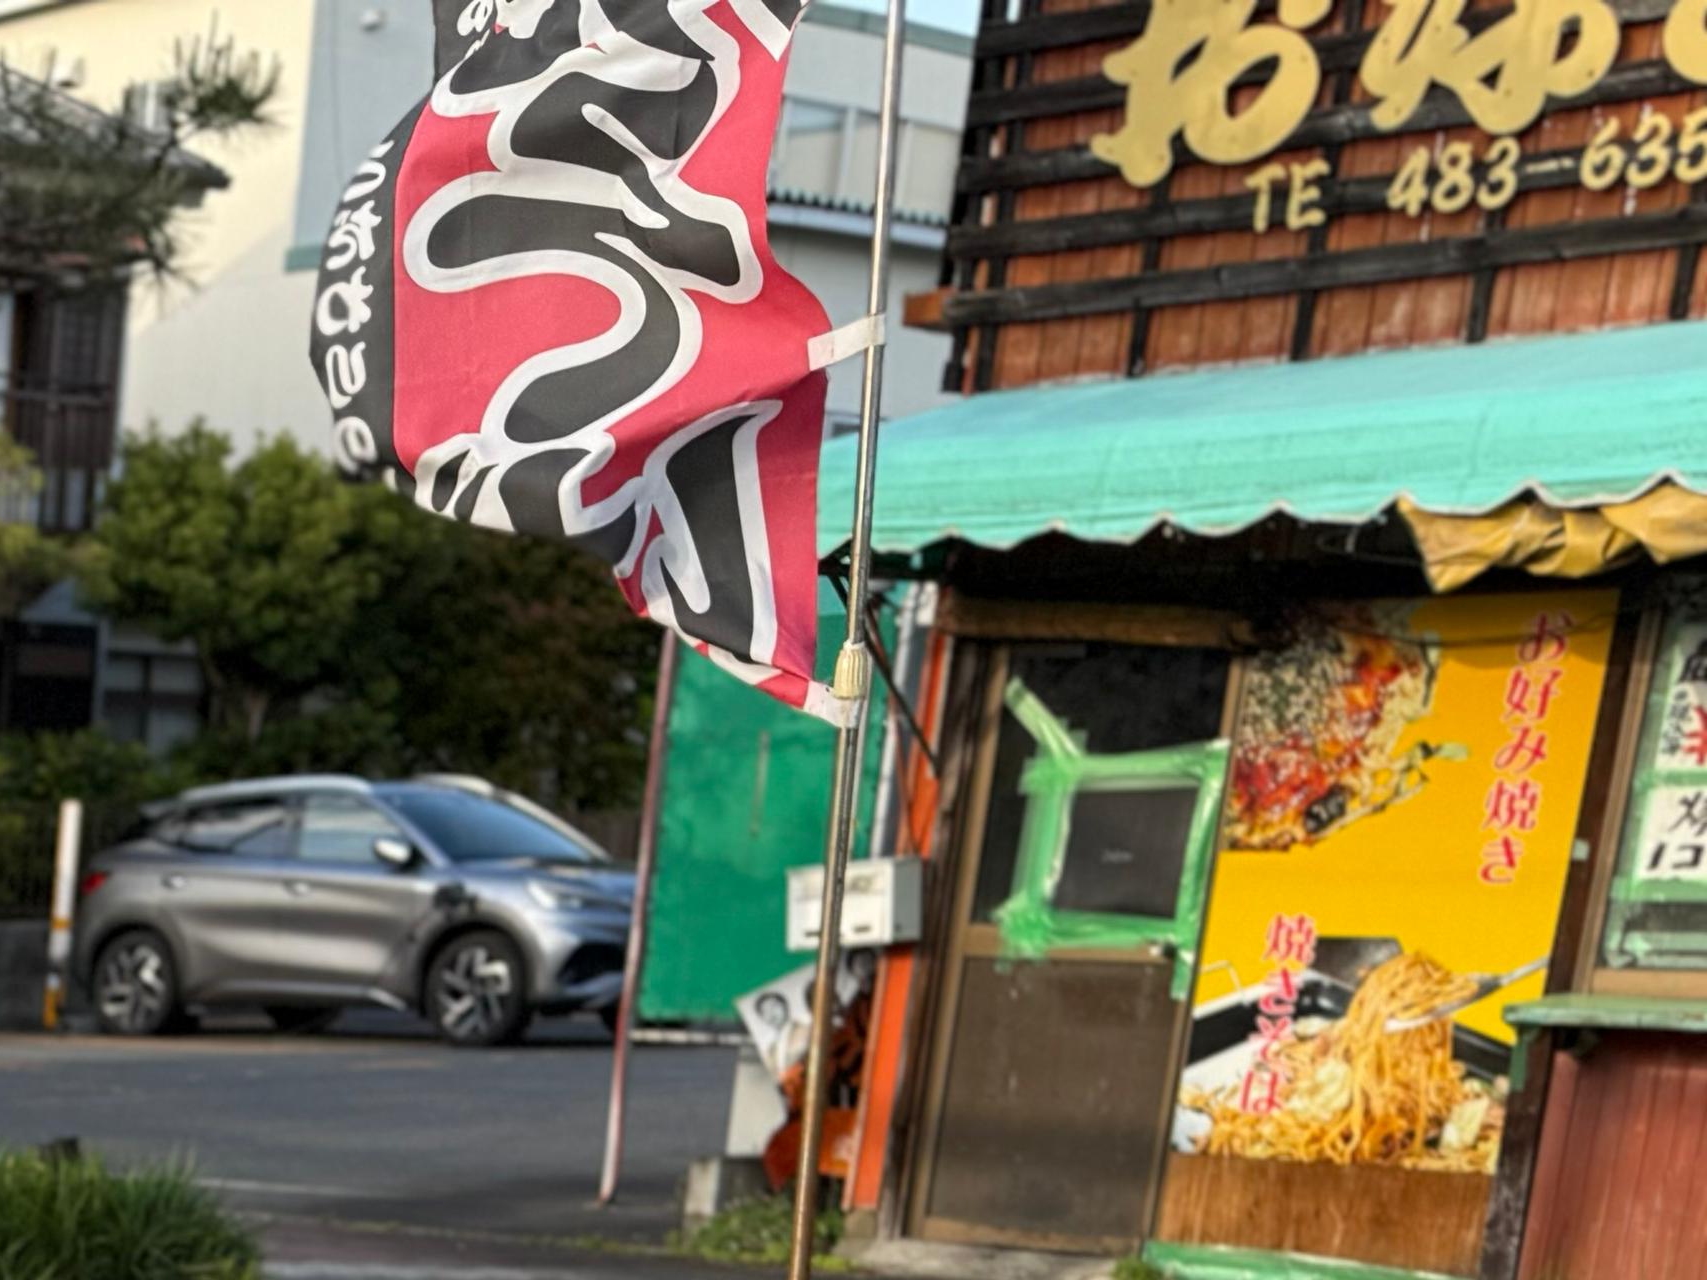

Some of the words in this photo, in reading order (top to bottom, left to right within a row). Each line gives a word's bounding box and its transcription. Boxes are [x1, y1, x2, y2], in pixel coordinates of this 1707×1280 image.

[1478, 611, 1577, 886] お好み焼き
